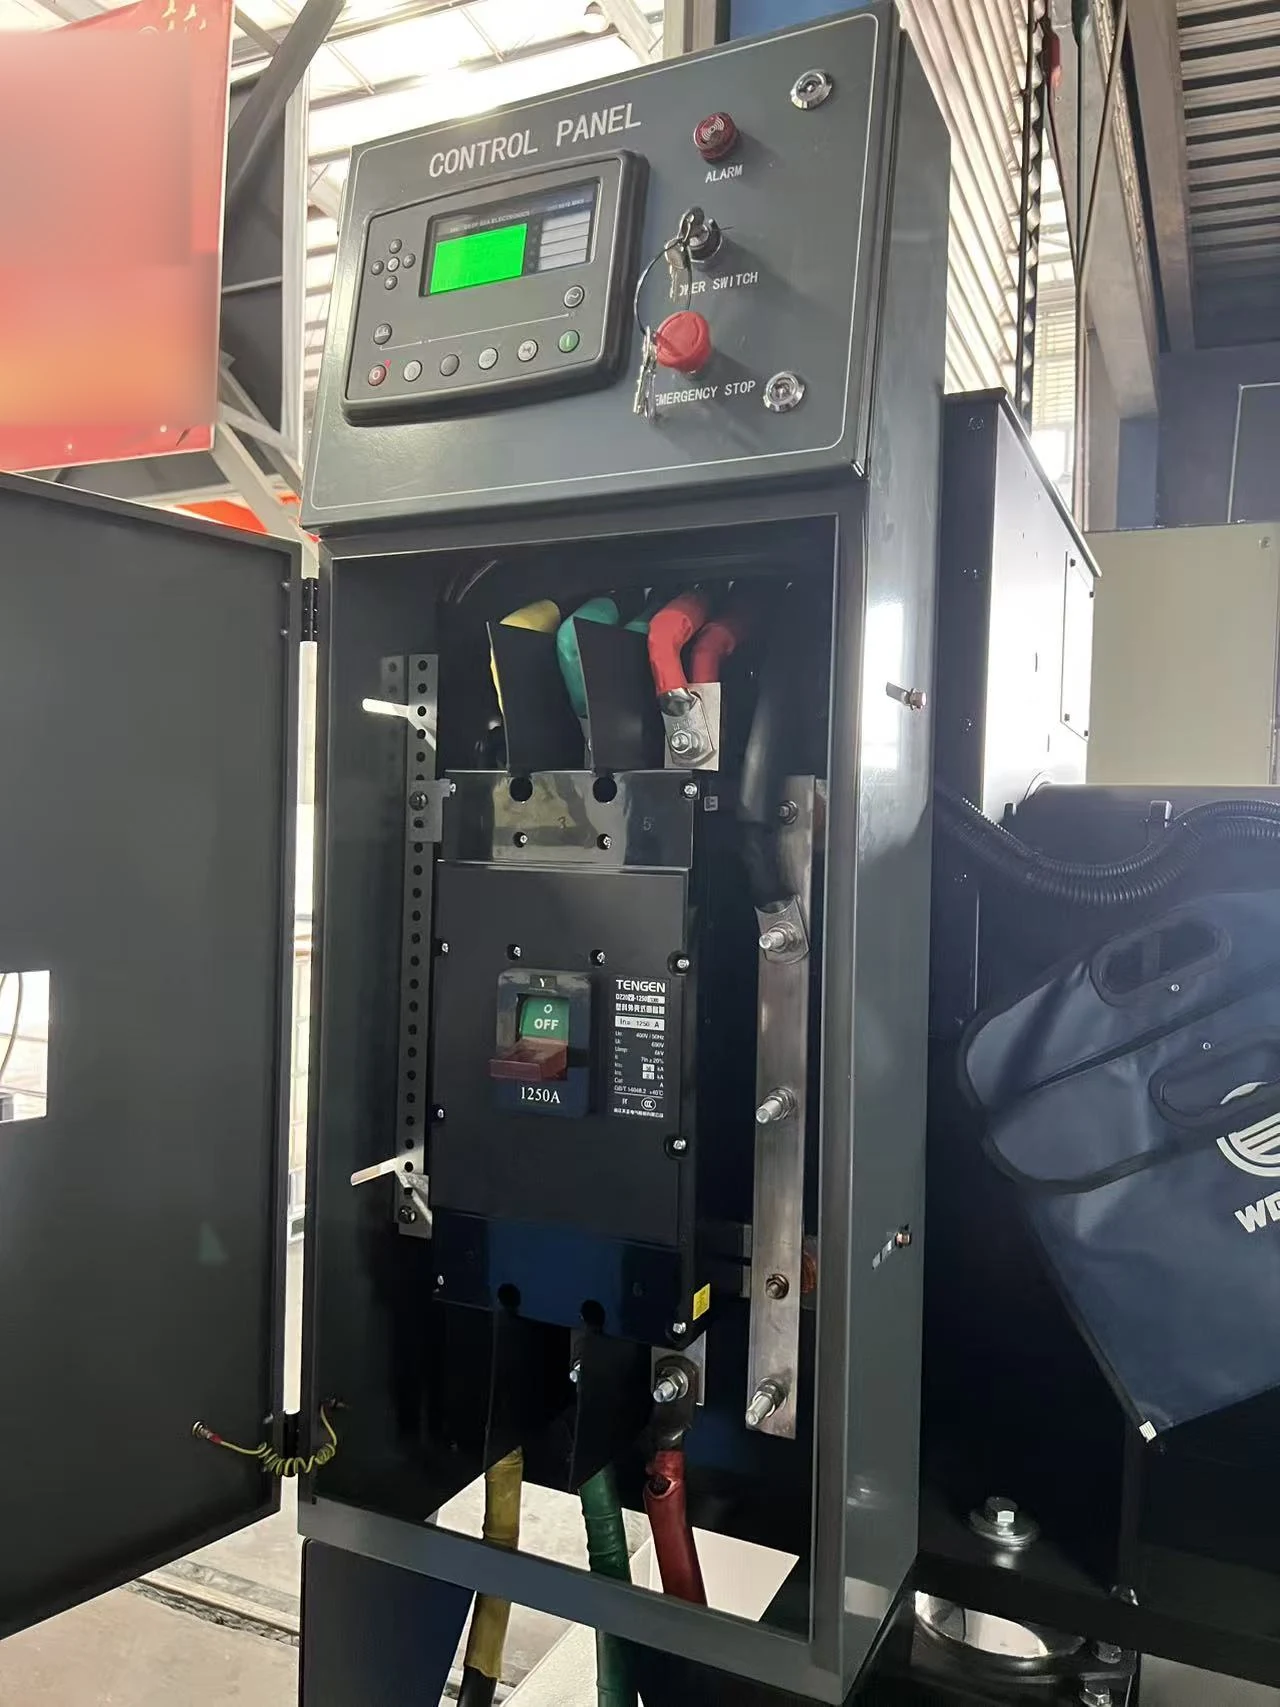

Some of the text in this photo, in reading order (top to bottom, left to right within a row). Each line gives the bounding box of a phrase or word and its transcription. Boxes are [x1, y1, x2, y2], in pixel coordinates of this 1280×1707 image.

[429, 102, 642, 178] CONTROL PANEL
[705, 164, 743, 184] ALARM
[713, 271, 759, 290] SWITCH
[724, 380, 756, 395] STOP
[615, 979, 666, 993] TENGEN
[534, 1018, 559, 1030] OFF
[521, 1086, 561, 1104] 1250A
